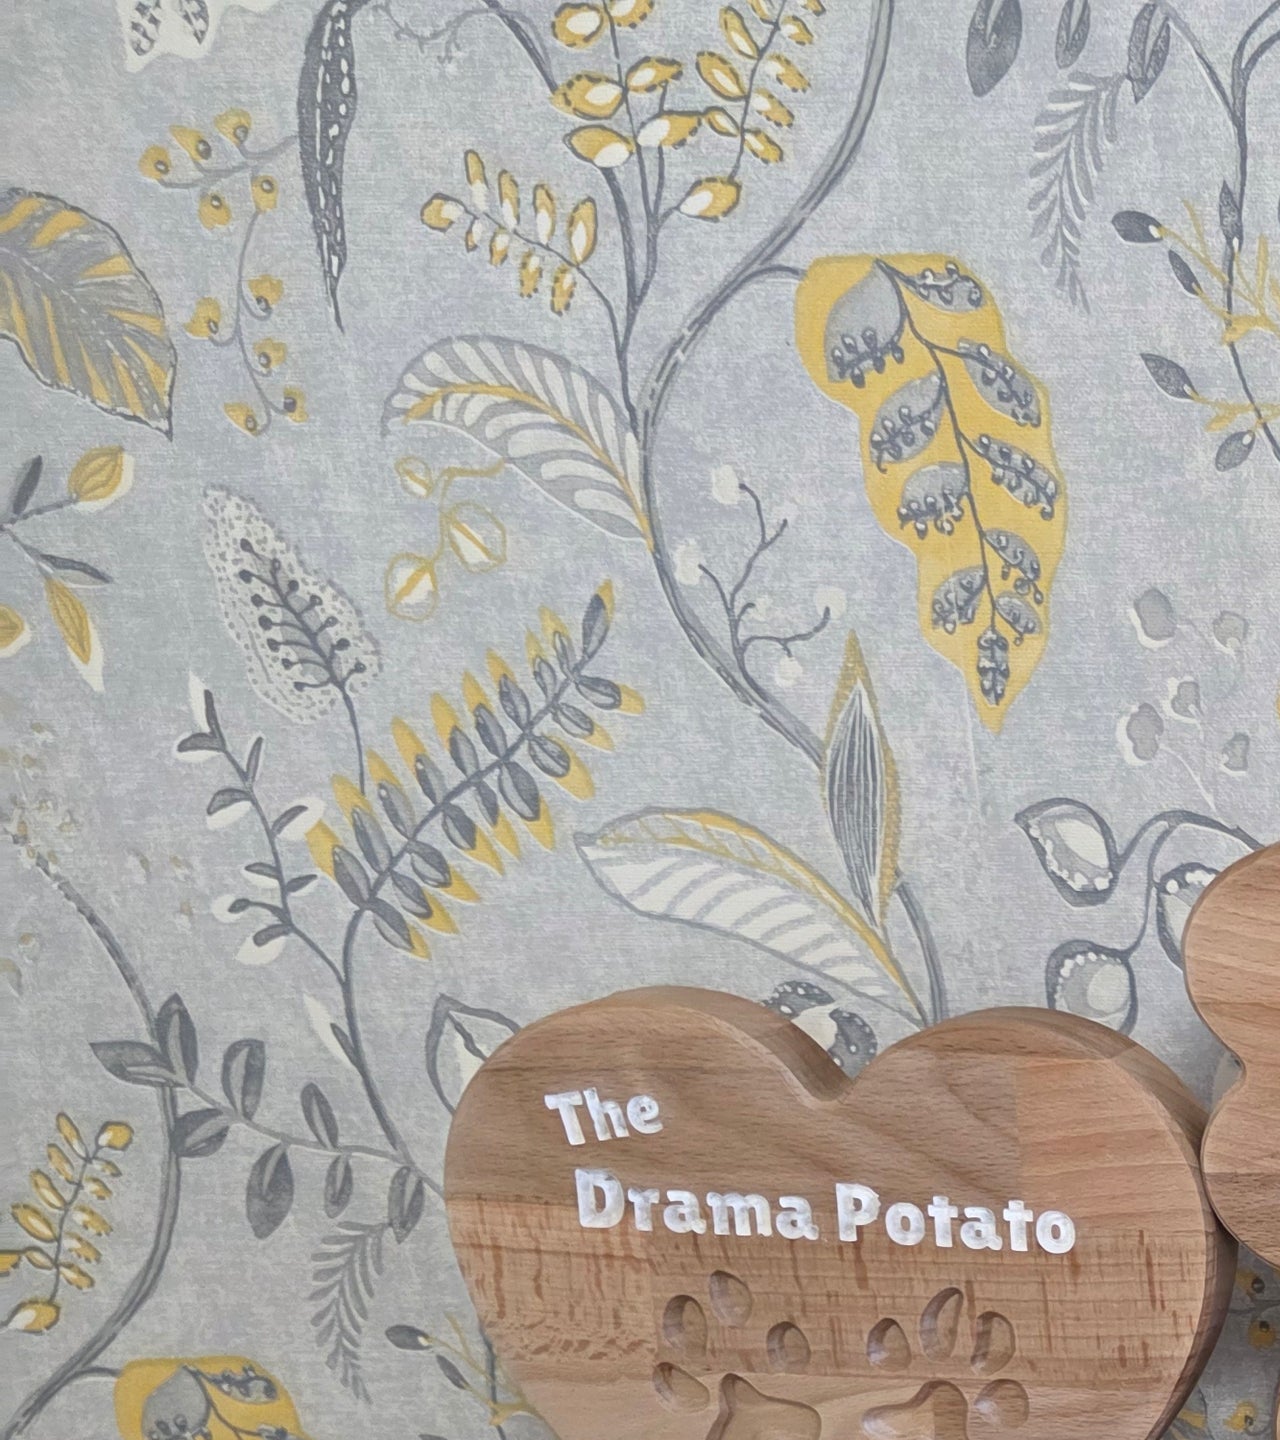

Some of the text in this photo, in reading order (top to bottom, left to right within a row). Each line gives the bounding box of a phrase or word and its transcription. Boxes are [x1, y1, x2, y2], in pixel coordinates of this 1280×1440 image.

[544, 1087, 663, 1145] The
[574, 1168, 1076, 1254] Drama Potato
